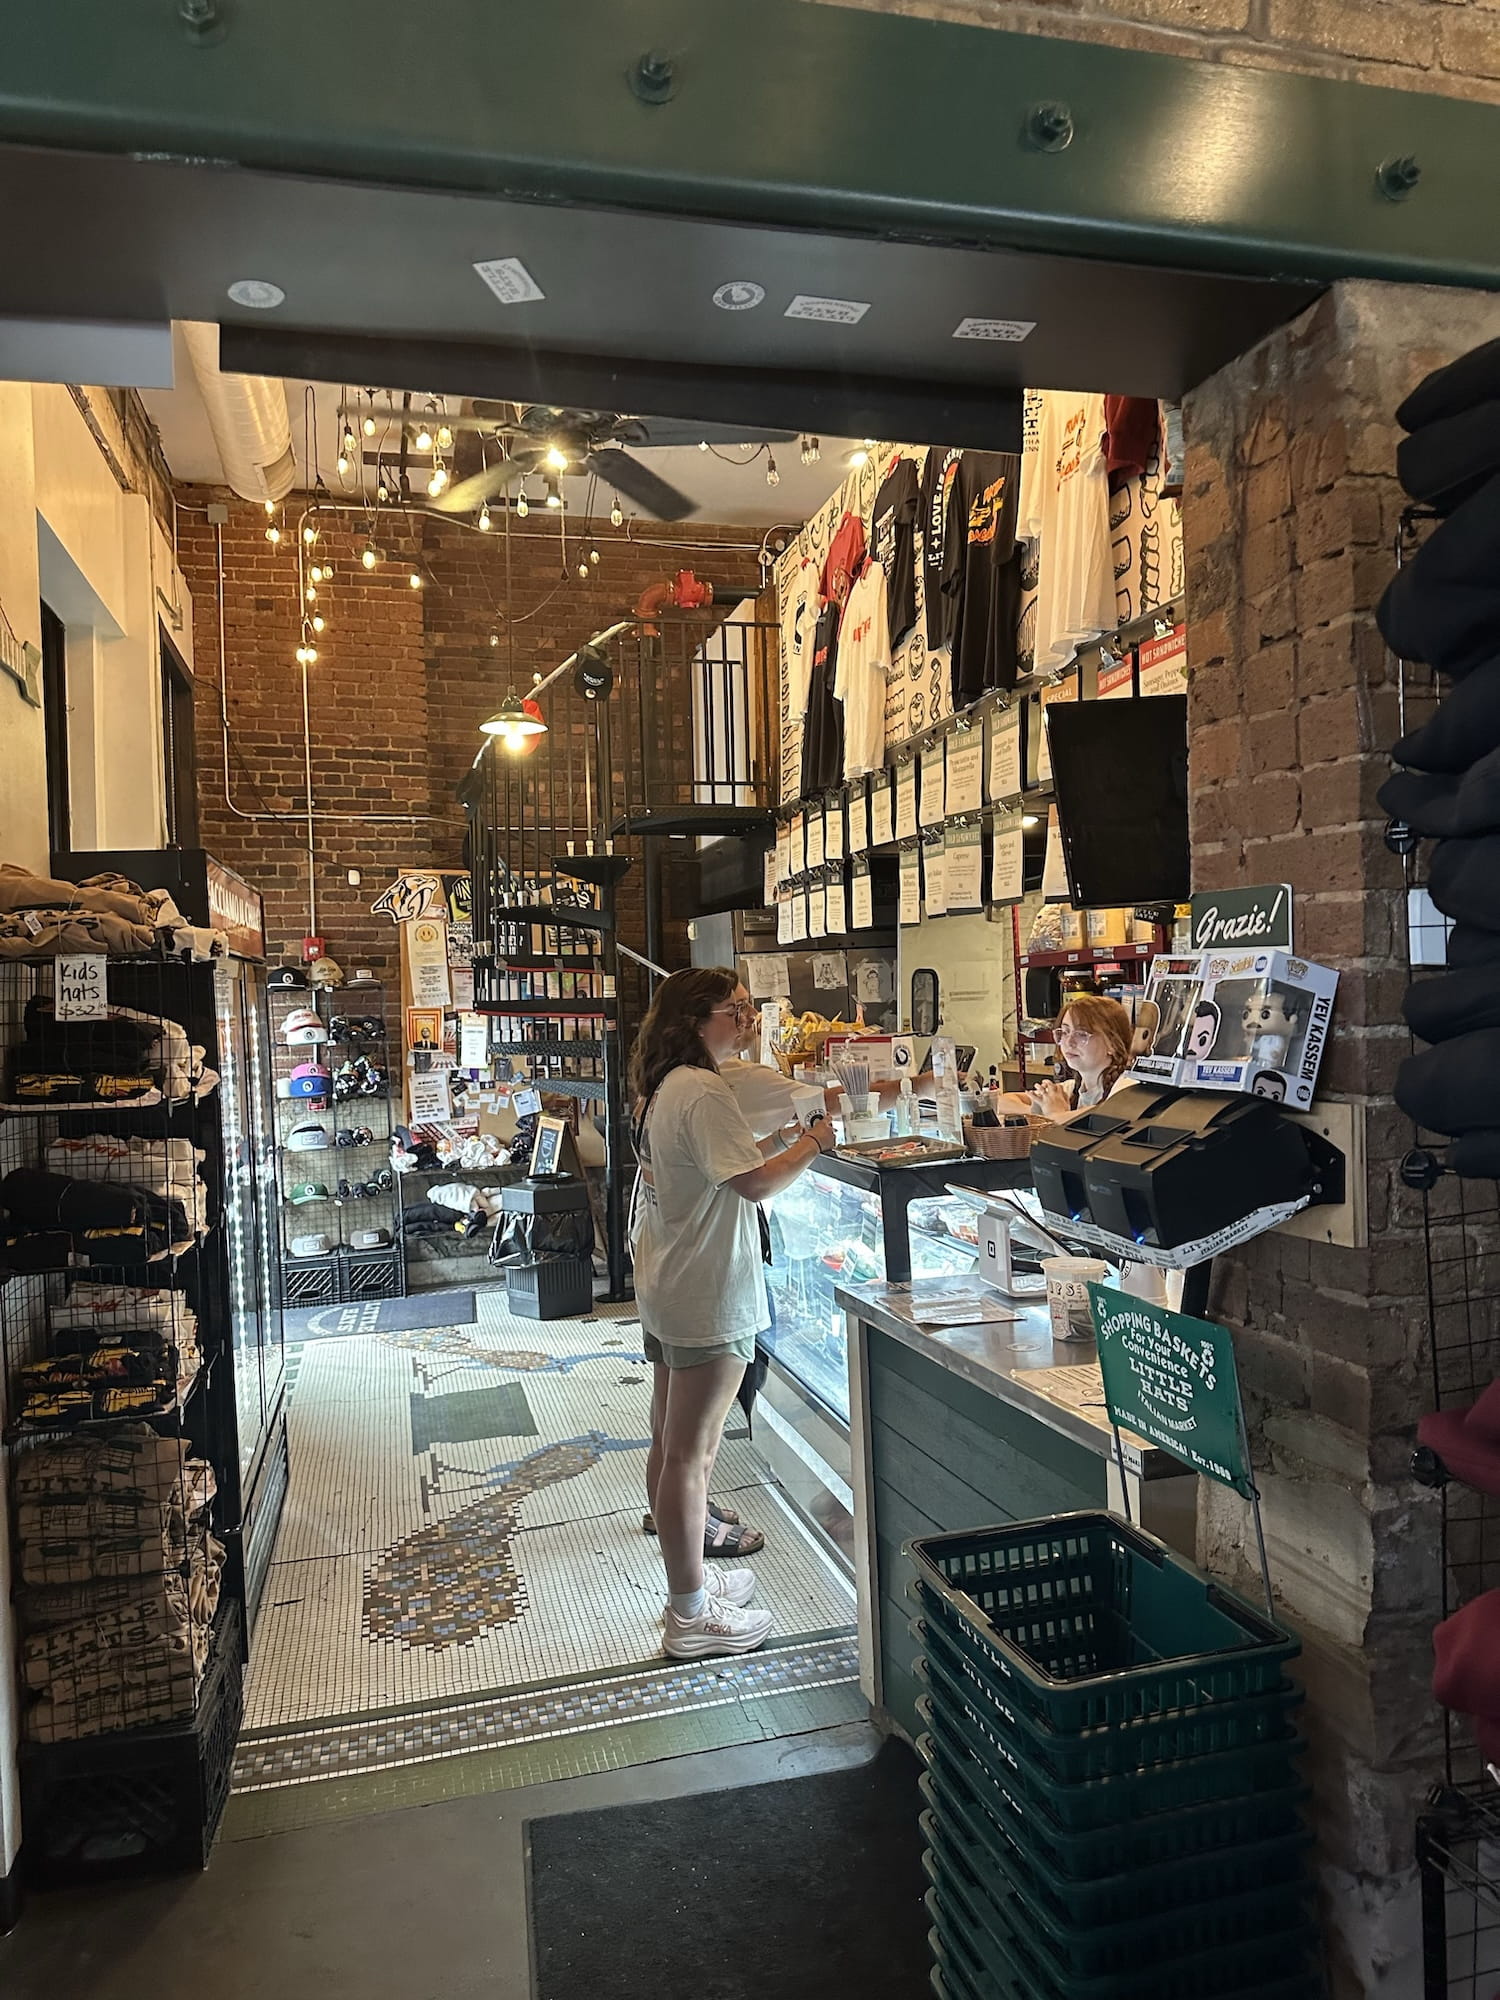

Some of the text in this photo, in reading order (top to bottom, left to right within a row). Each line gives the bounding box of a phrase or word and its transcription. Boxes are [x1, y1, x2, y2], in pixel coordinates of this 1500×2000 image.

[931, 493, 942, 535] LOVE
[1153, 634, 1186, 660] SANDWICHE
[1047, 688, 1072, 703] SPECIAL
[1196, 890, 1283, 951] Grazie!
[61, 983, 100, 1002] hats
[1300, 997, 1331, 1082] YEV KASSEM
[1101, 1312, 1216, 1391] SHOPPING BASKETS
[1131, 1328, 1145, 1344] For
[1122, 1335, 1188, 1378] Convenience
[1129, 1357, 1193, 1398] LITTLE
[1140, 1379, 1189, 1412] HATS
[1113, 1405, 1137, 1426] MADE
[1137, 1390, 1197, 1432] ITALIAN MARKET
[703, 1622, 732, 1634] HOKA
